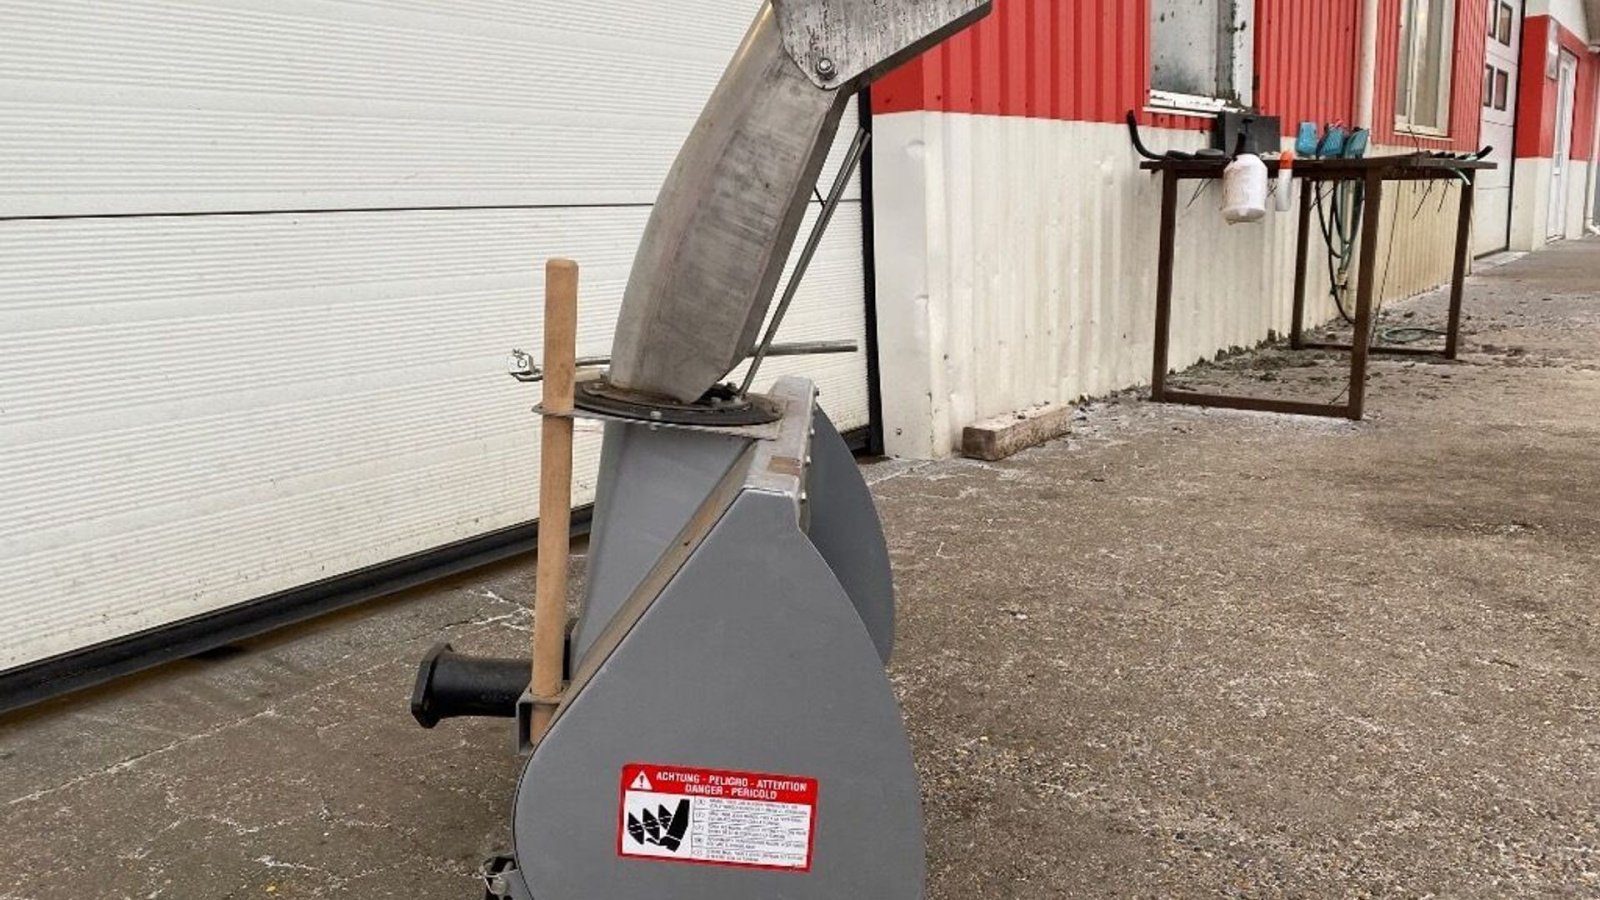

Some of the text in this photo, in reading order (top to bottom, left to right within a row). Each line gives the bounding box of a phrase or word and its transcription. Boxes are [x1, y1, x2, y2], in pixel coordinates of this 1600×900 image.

[656, 771, 700, 783] ACHTUNG
[709, 775, 748, 787] PELIGRO
[756, 779, 807, 792] ATTENTION
[685, 783, 723, 795] DANGER
[731, 786, 777, 799] PERICOLO
